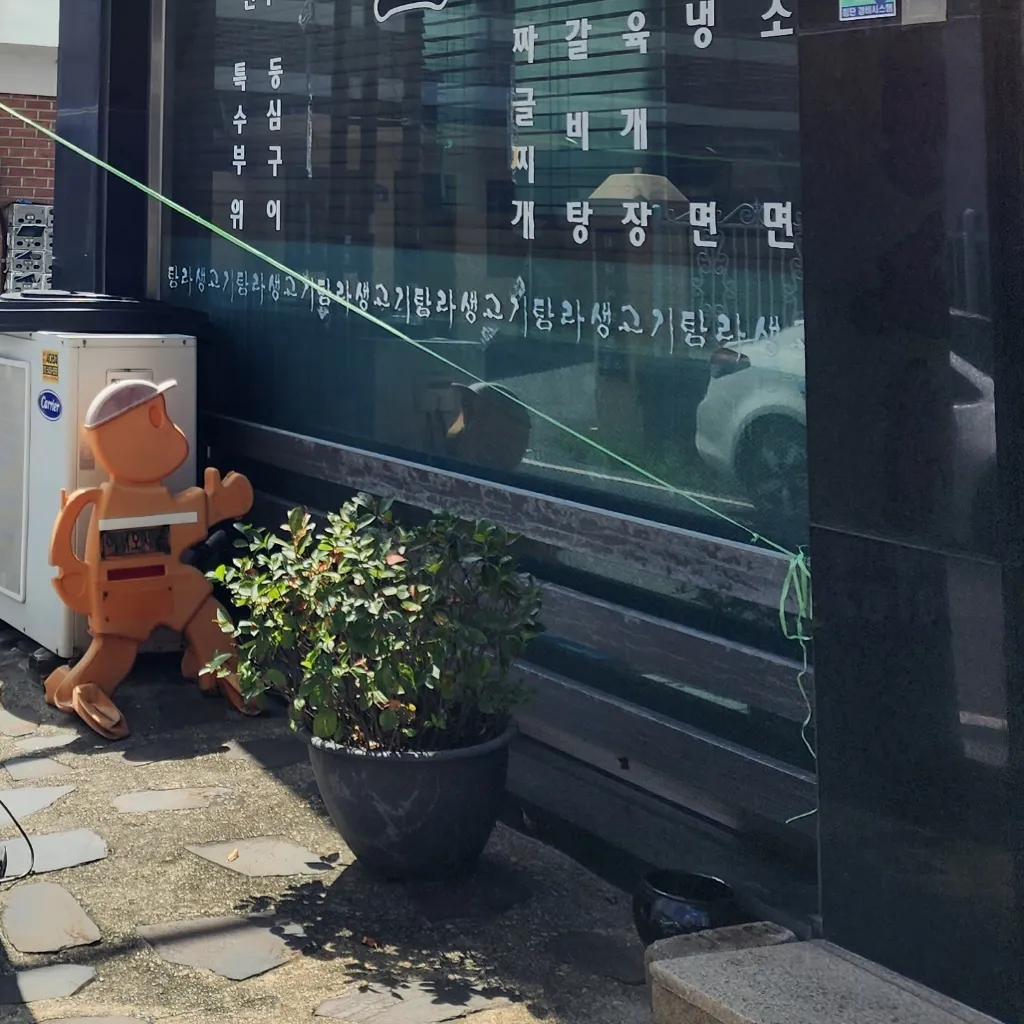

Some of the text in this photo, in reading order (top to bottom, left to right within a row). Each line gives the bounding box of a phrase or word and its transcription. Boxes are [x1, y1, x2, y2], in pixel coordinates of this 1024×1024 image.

[230, 61, 248, 230] 특수부위
[266, 57, 283, 230] 등심구이
[512, 25, 539, 240] 짜글찌개
[565, 18, 593, 245] 갈비탕
[620, 11, 653, 247] 육개장
[686, 0, 718, 248] 냉면
[40, 394, 60, 413] Carrier
